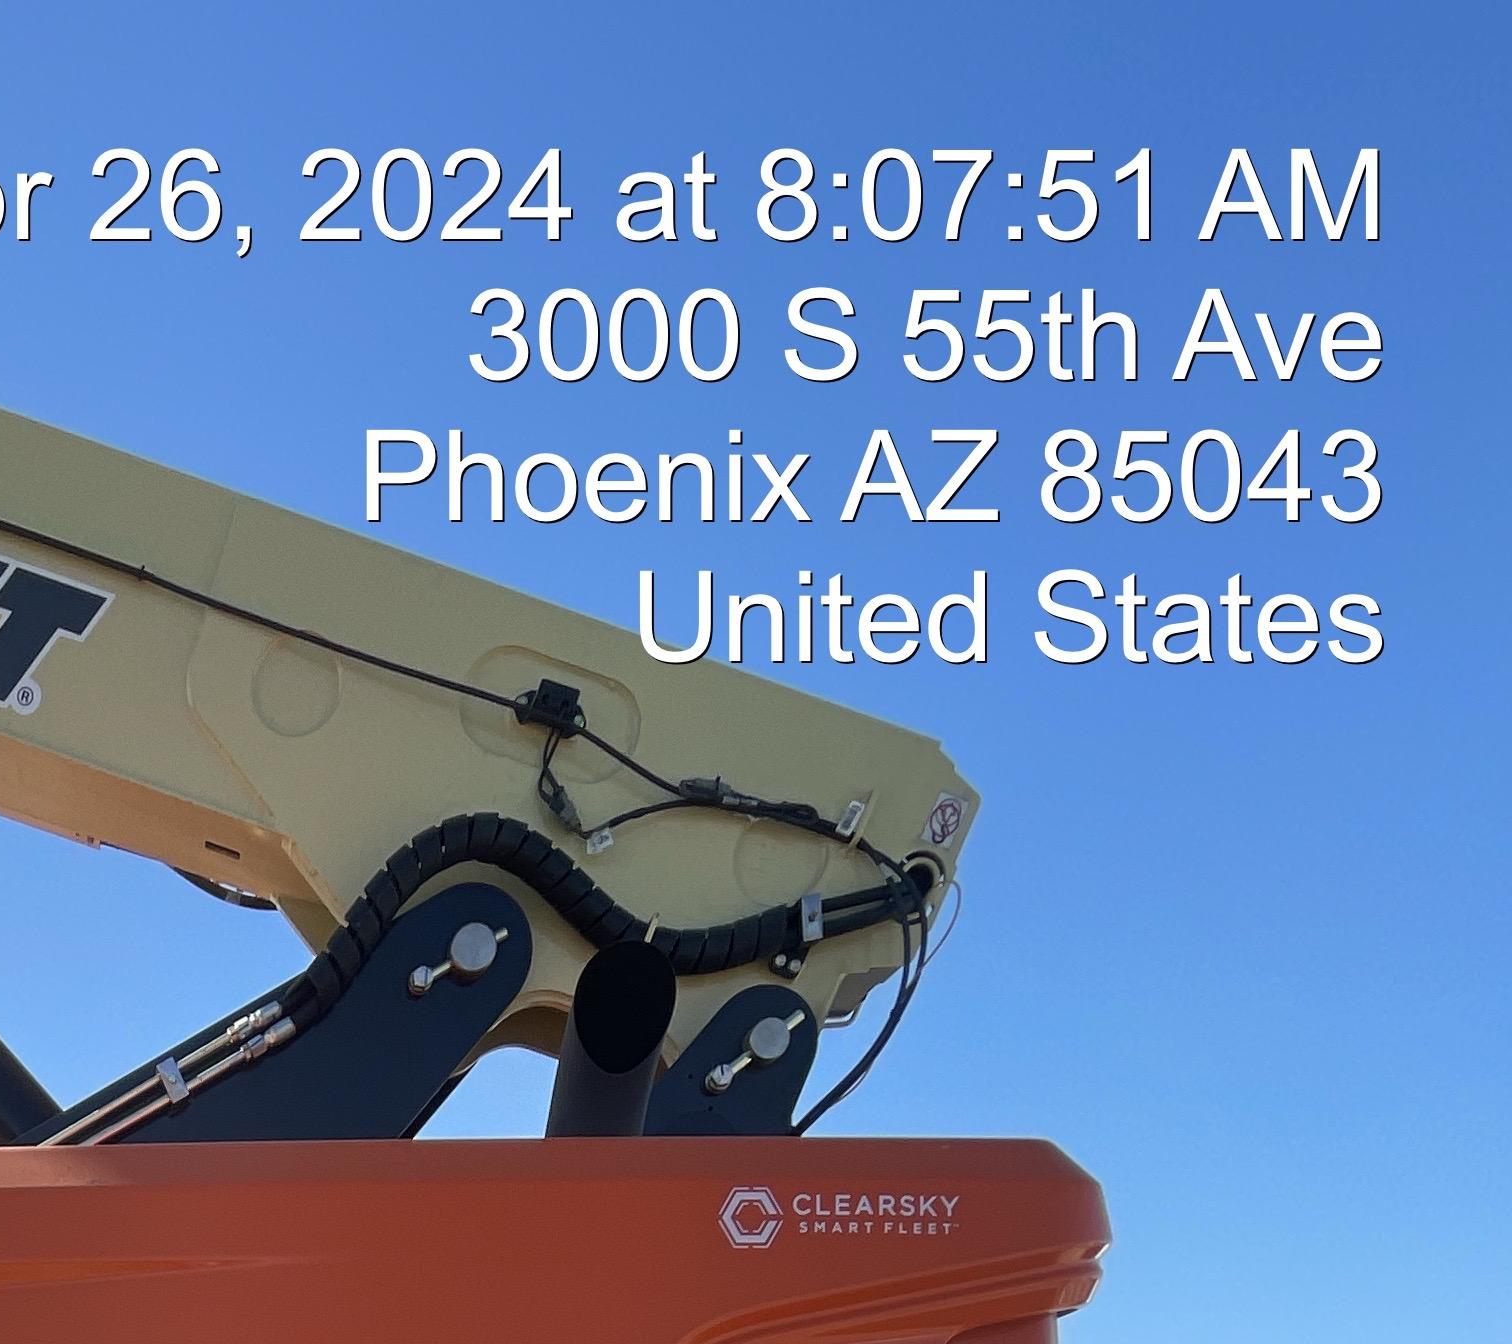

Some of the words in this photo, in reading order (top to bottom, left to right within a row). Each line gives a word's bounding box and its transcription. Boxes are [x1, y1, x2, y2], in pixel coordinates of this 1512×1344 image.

[792, 1193, 960, 1217] CLEARSKY
[799, 1220, 874, 1234] SMART
[884, 1221, 951, 1235] FLEET
